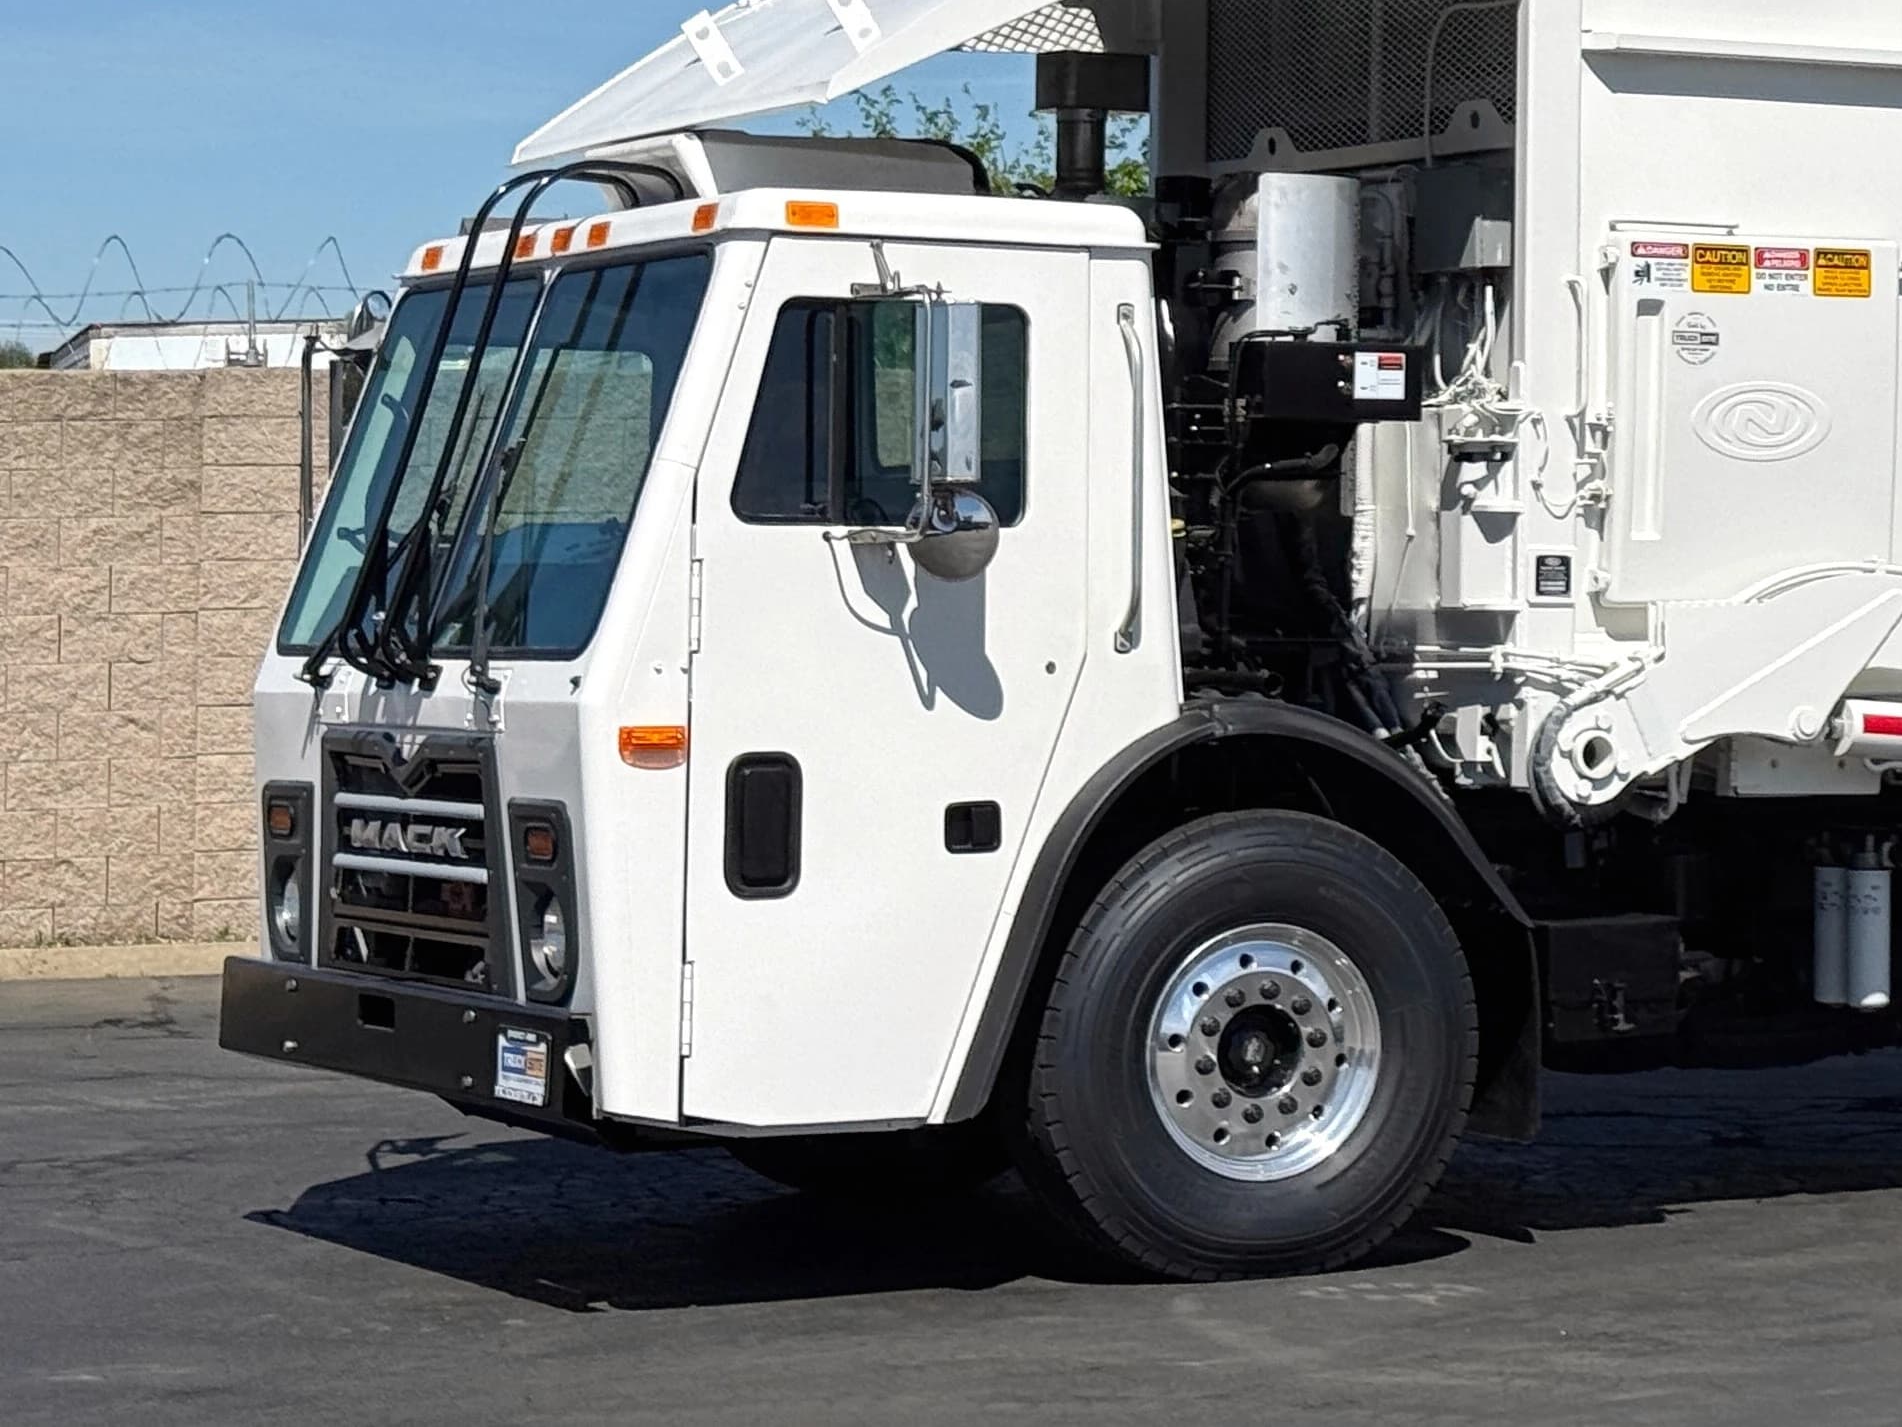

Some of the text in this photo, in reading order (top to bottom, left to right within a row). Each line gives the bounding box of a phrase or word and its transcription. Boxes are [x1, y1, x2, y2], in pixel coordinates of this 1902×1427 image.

[1696, 249, 1747, 264] CAUTION
[1825, 253, 1867, 267] CAUTION
[1755, 272, 1808, 281] DO NOT ENTER
[351, 818, 469, 859] MACK
